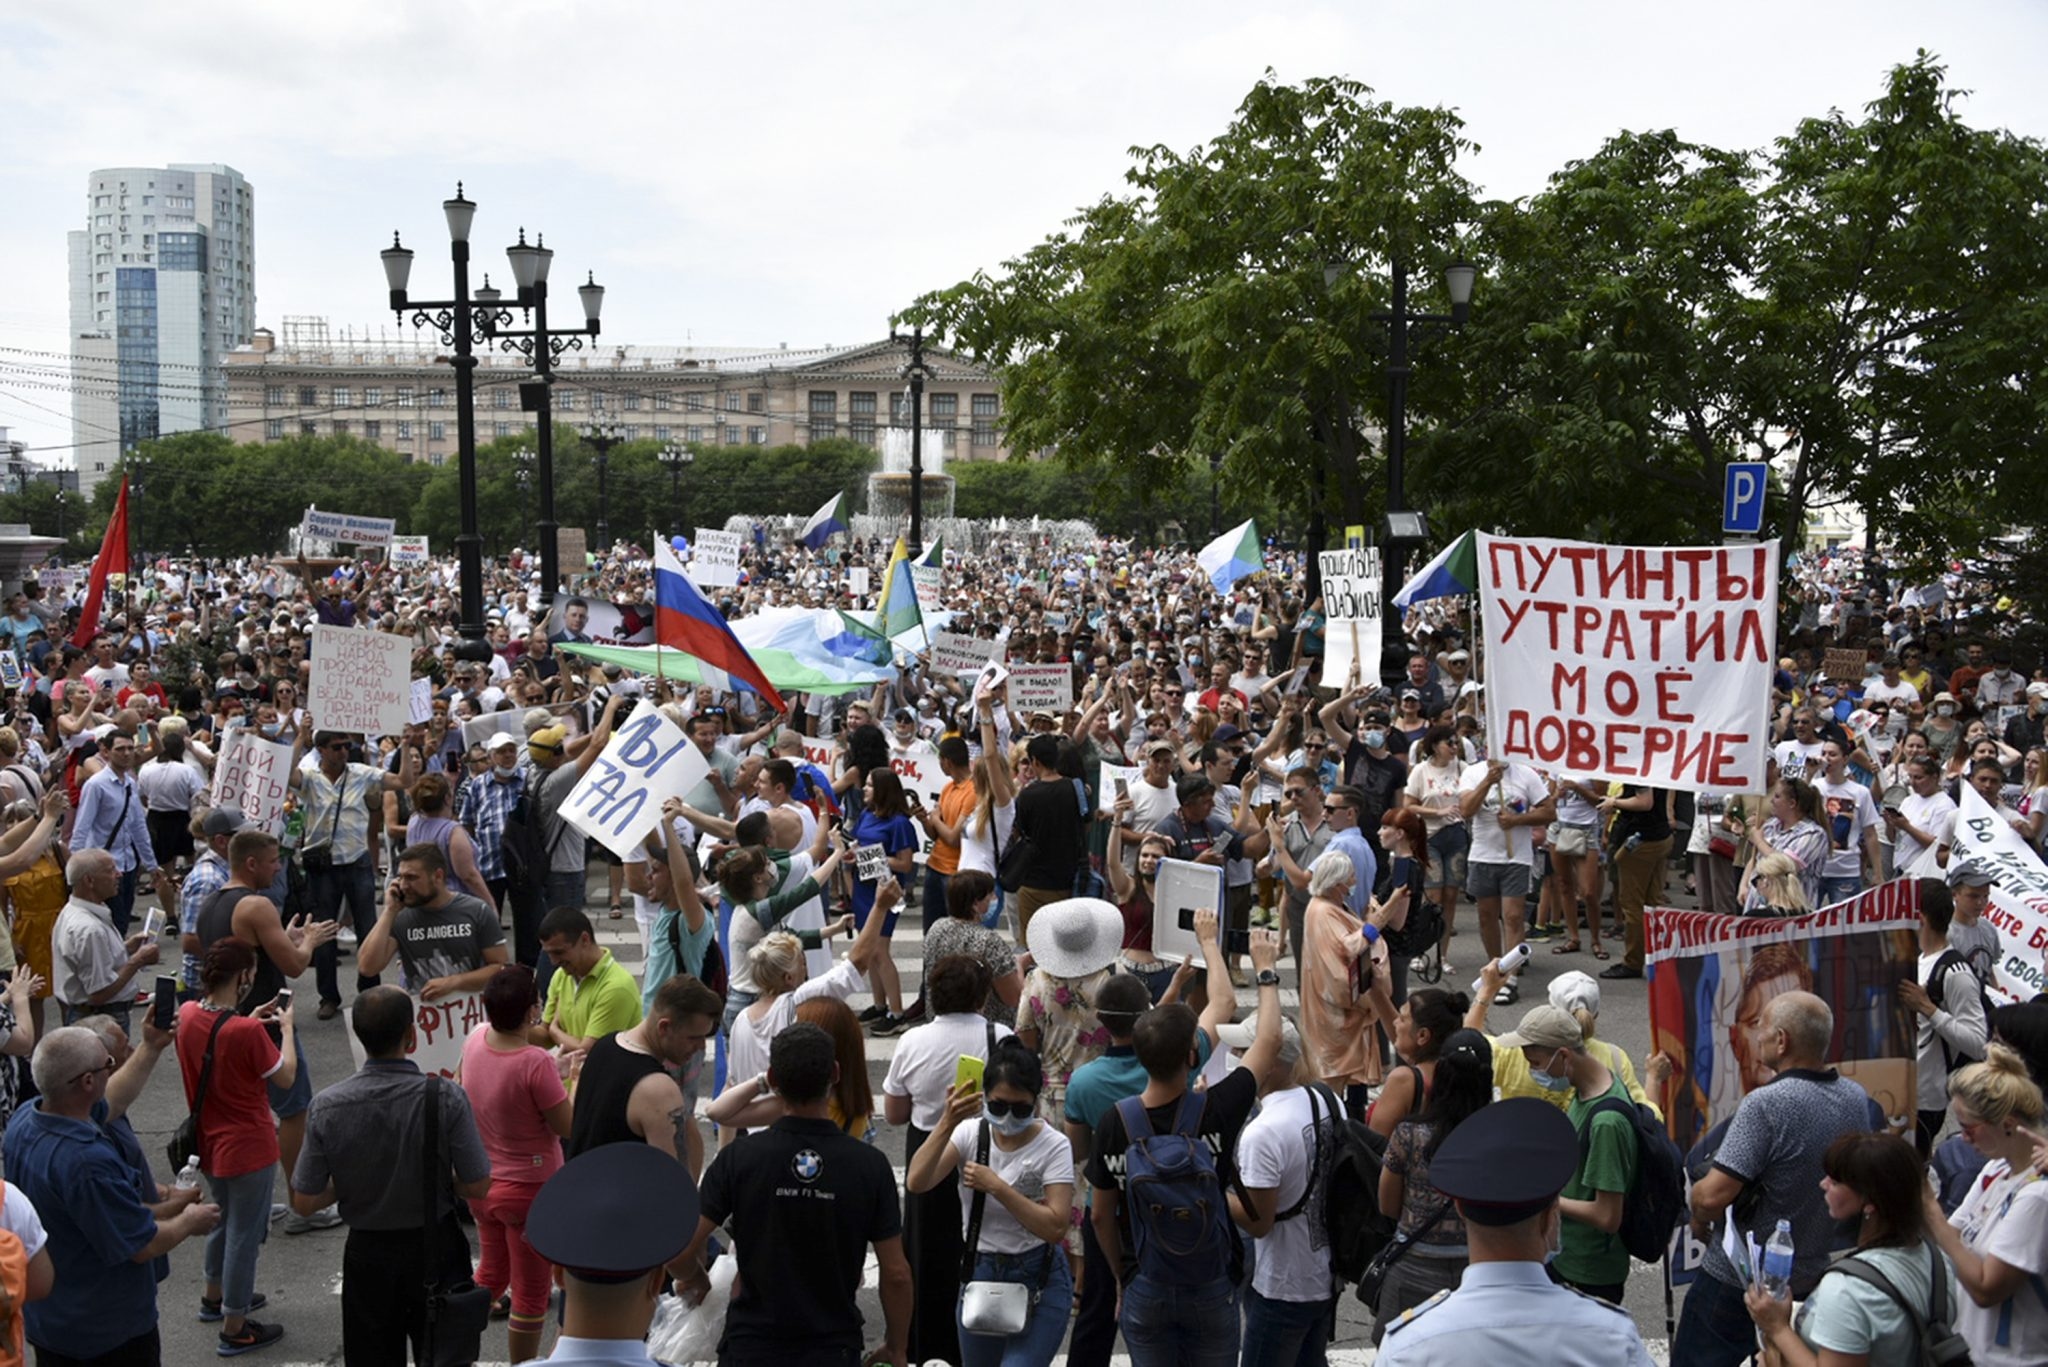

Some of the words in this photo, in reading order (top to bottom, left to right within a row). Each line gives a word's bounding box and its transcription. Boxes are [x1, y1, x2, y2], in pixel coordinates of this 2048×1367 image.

[1732, 471, 1755, 521] P
[1497, 599, 1768, 662] УТРАТИЛ
[320, 629, 395, 651] ПРОСНИСЬ
[337, 647, 385, 665] НАРОД
[318, 658, 392, 678] ПРОСНИСЬ
[327, 674, 382, 689] СТРАНА
[324, 701, 381, 715] ПРАВИТ
[324, 715, 382, 730] САТАНА
[1504, 709, 1748, 786] ДОВЕРИЕ
[407, 928, 425, 941] LOS
[427, 923, 472, 940] ANGELES
[776, 1187, 798, 1196] BMW
